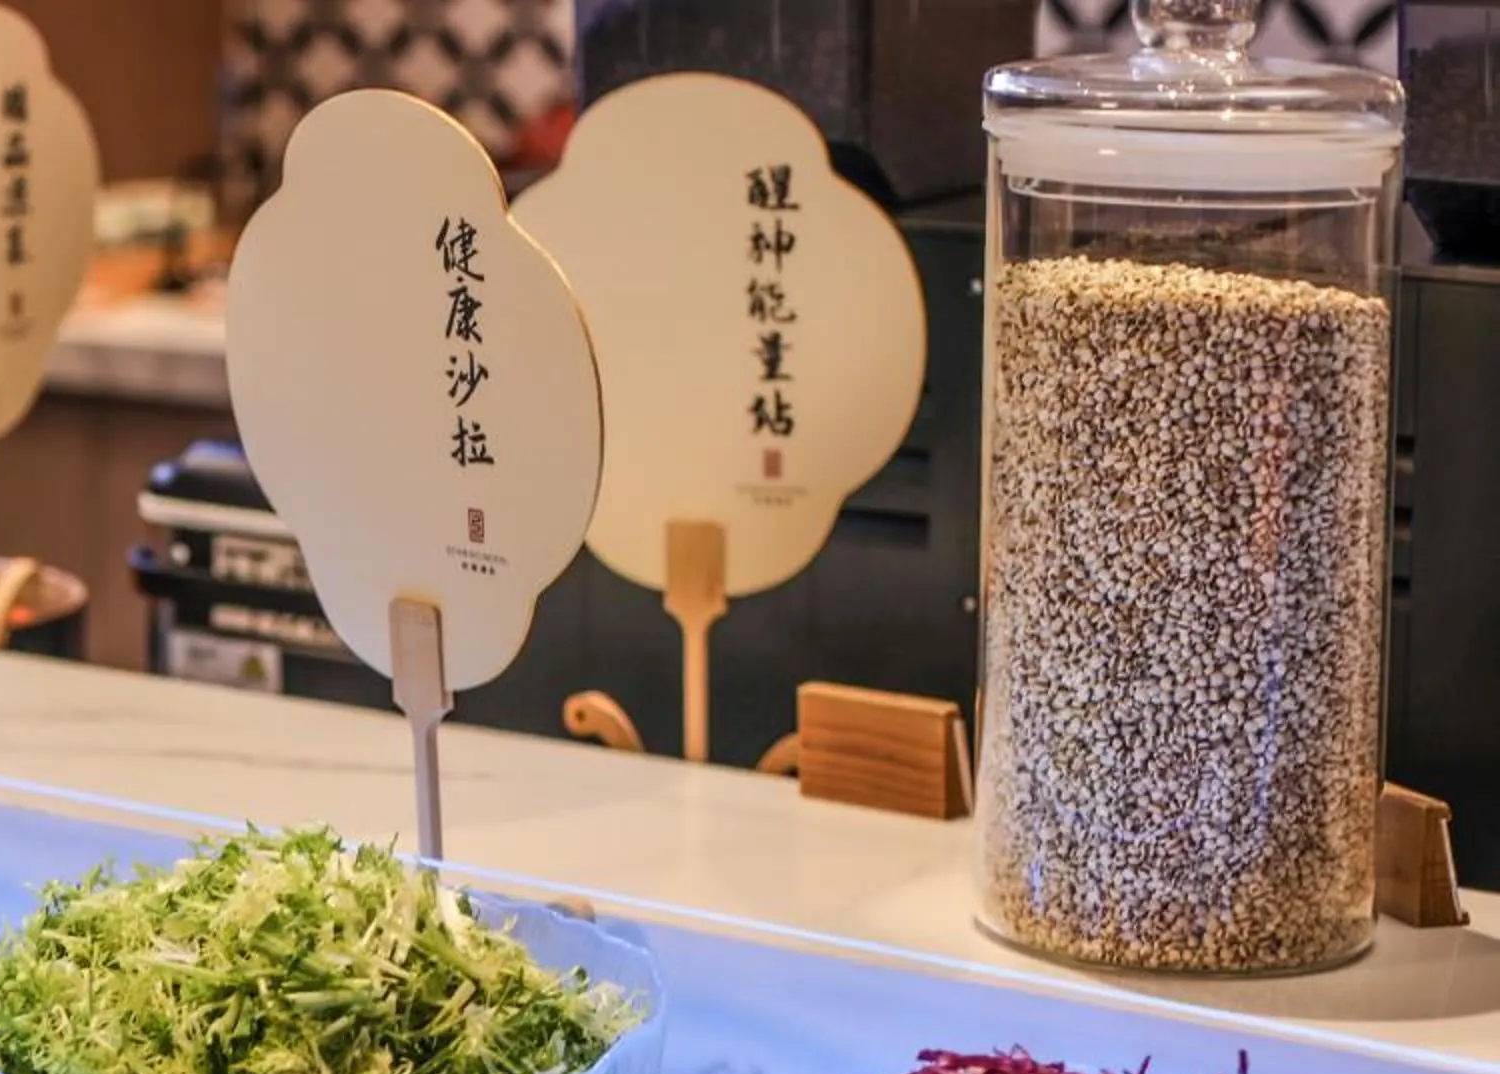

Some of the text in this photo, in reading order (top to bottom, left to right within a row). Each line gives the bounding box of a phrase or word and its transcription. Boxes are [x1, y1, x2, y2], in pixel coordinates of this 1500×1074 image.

[435, 216, 495, 468] 健康沙拉
[745, 164, 800, 437] 醒神能量站
